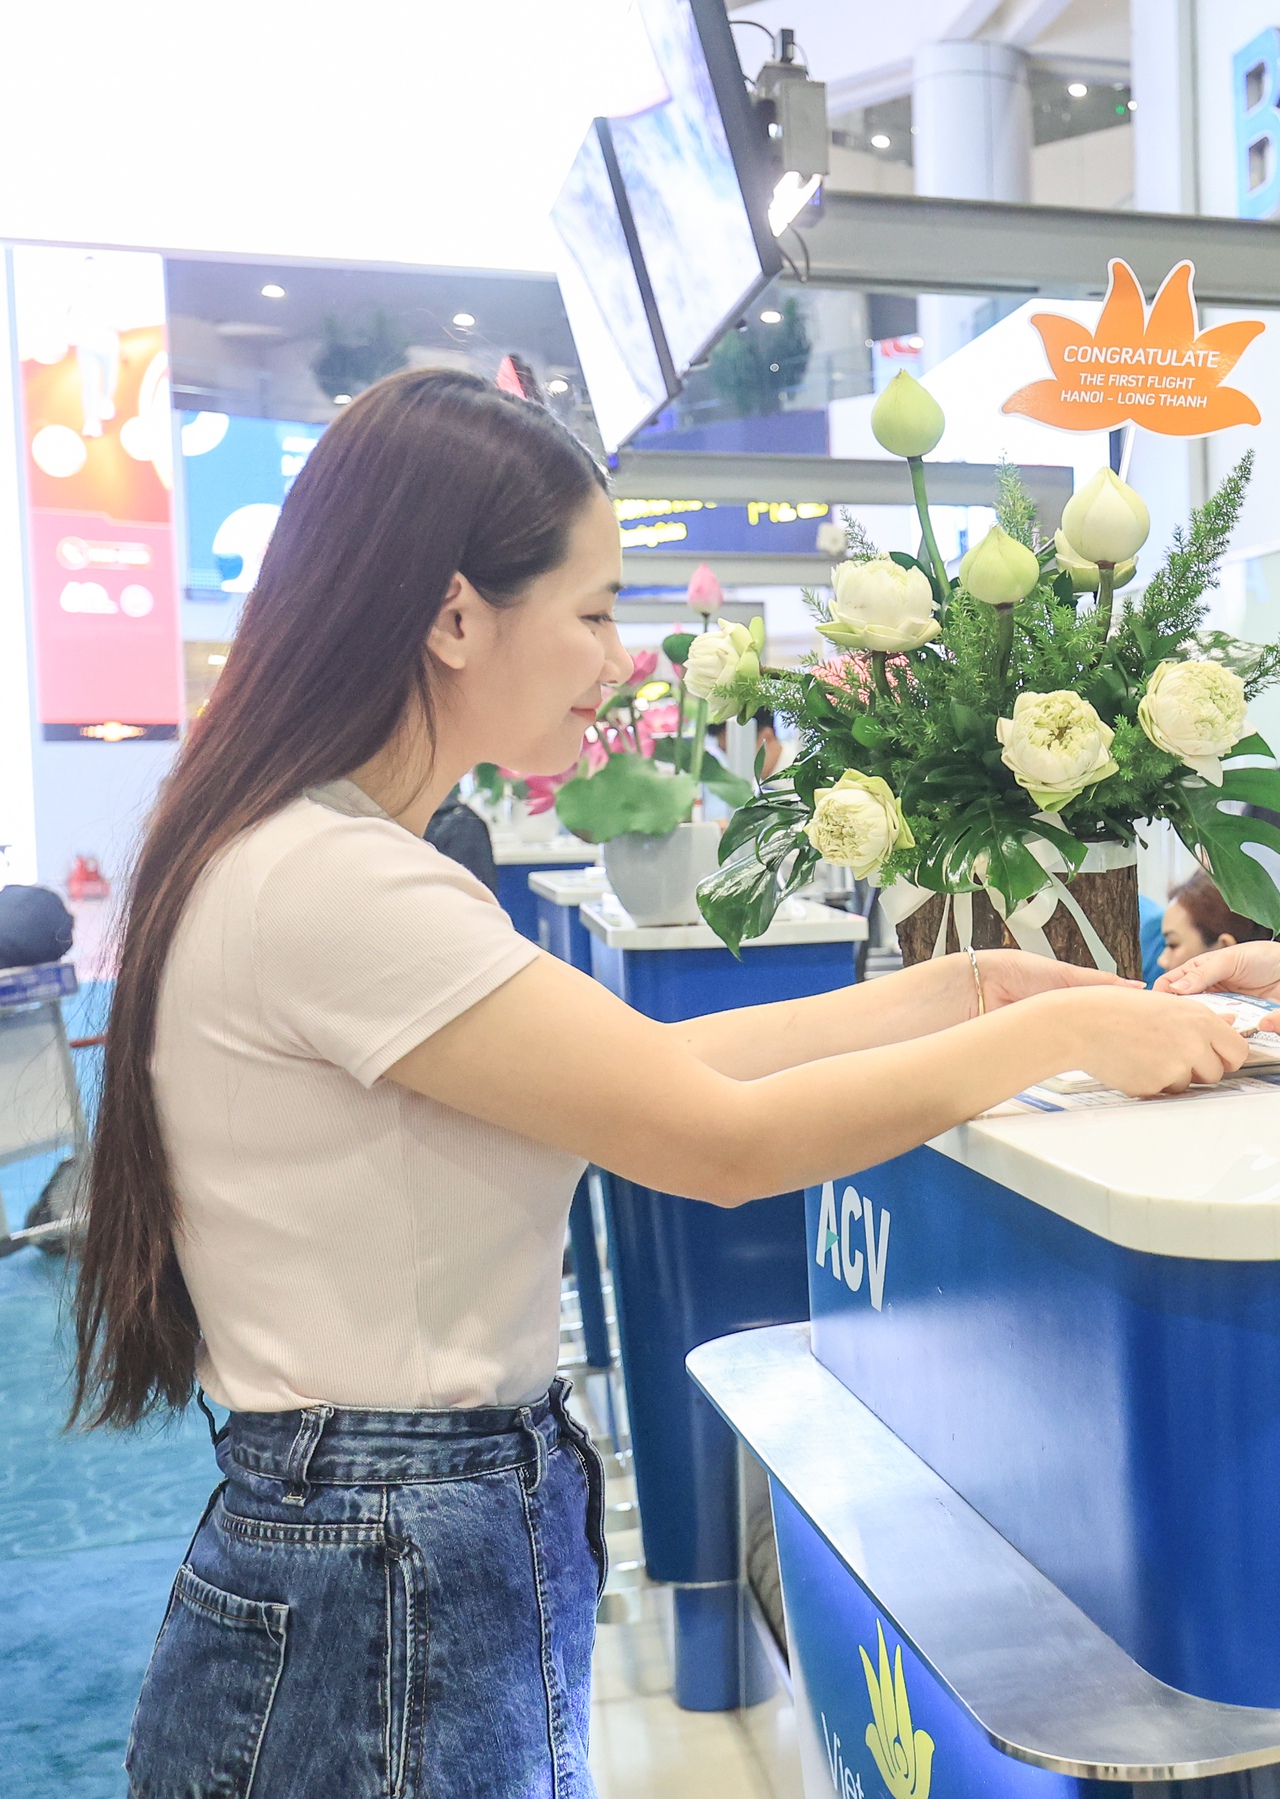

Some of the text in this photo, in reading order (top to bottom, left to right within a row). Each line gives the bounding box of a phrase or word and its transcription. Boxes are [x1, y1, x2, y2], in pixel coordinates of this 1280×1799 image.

[1063, 345, 1220, 368] CONGRATULATE
[1079, 373, 1195, 390] THE FIRST FLIGHT
[1060, 390, 1104, 403] HANOI
[1117, 392, 1155, 405] LONG
[1158, 394, 1207, 408] THANH
[816, 1180, 891, 1312] ACV
